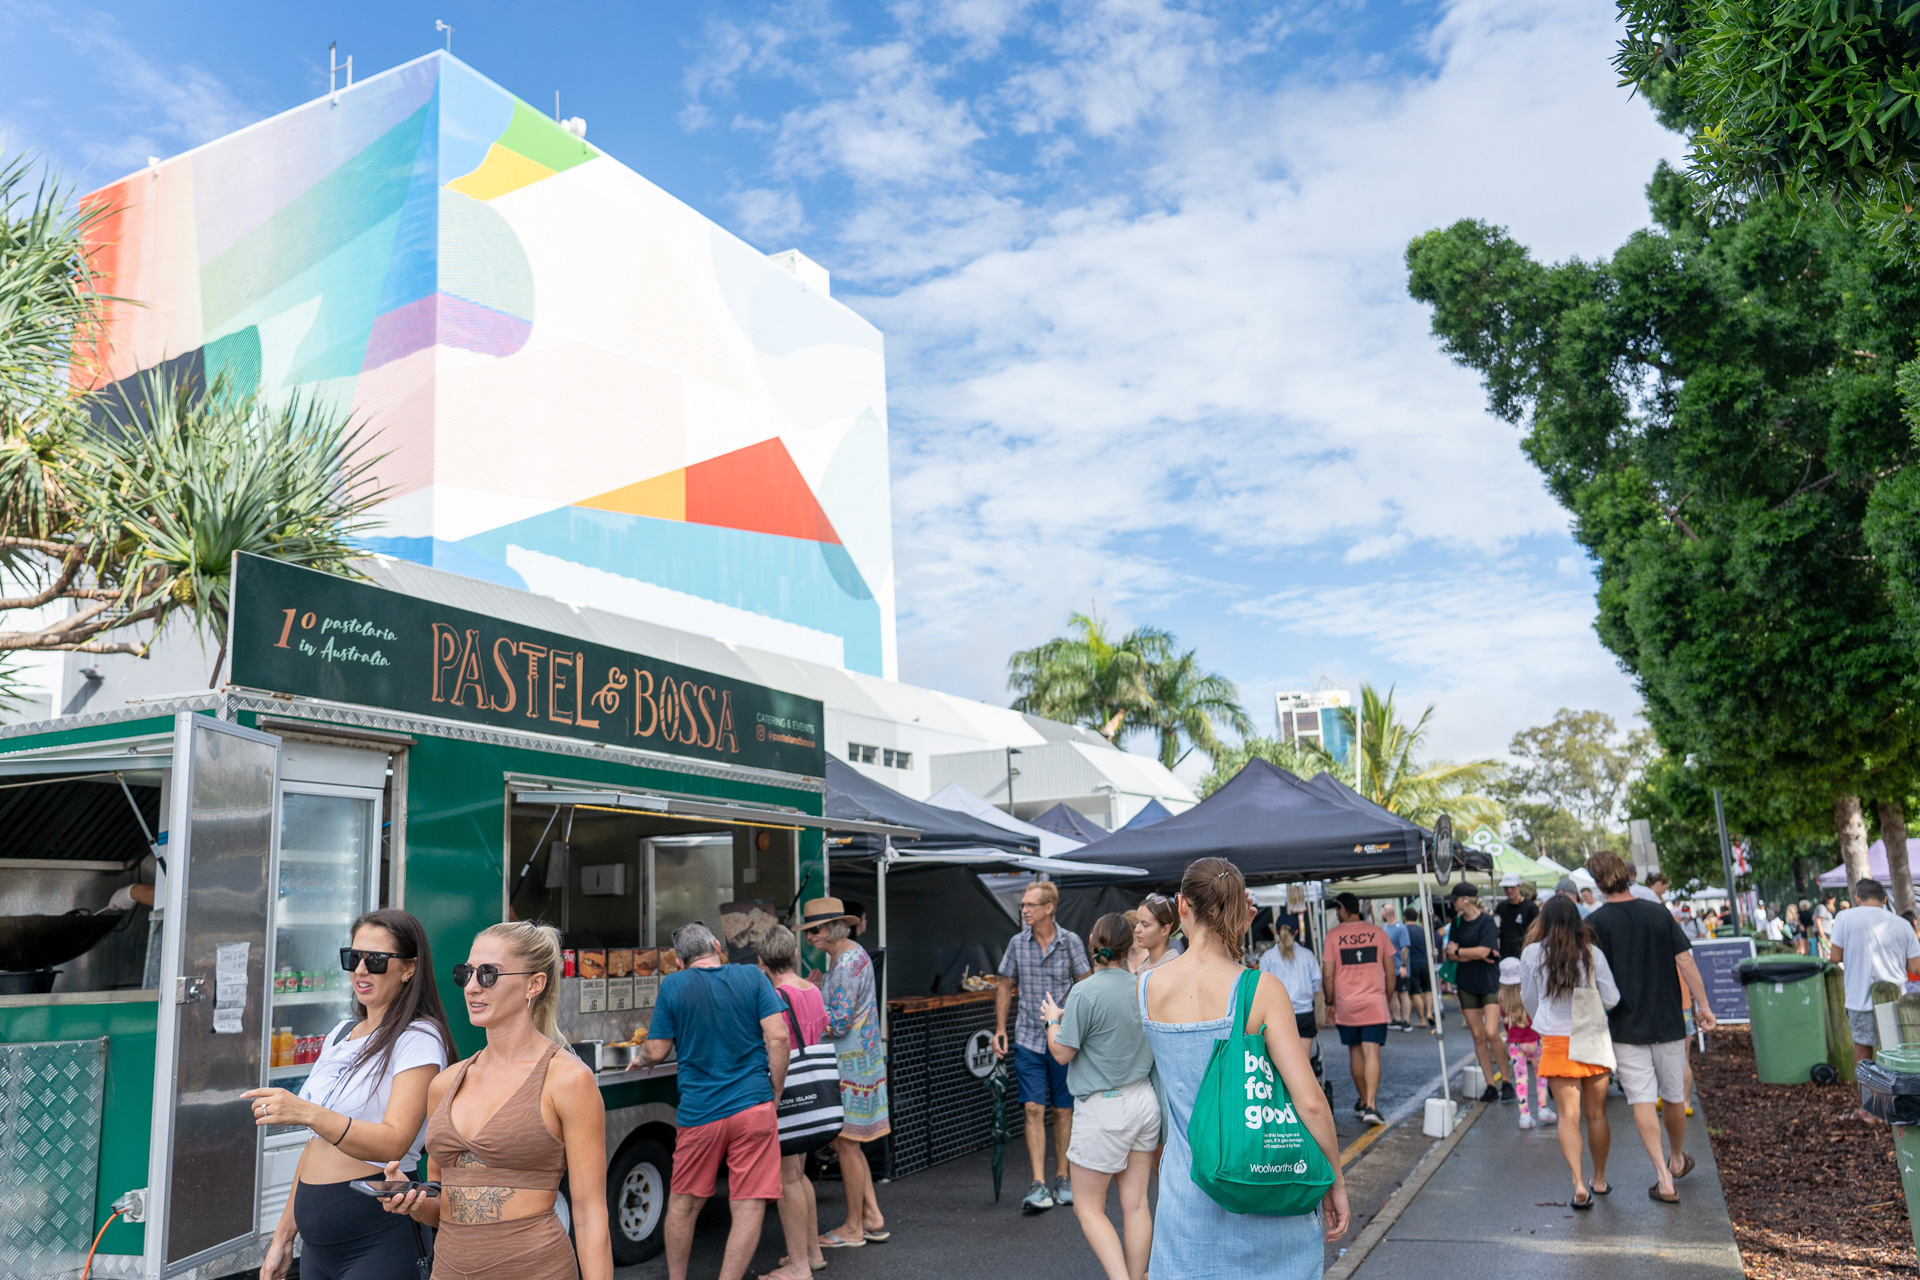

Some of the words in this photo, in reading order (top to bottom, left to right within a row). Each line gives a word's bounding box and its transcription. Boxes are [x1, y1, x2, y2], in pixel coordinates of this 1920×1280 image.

[321, 617, 398, 641] pastelaria
[299, 638, 317, 656] in
[320, 636, 391, 666] Australia
[431, 622, 600, 729] PASTEL
[591, 666, 628, 714] &
[633, 667, 740, 753] BOSSA
[756, 712, 786, 728] CATERING
[792, 720, 815, 734] EVENTS
[1338, 932, 1375, 945] KSCY
[795, 1093, 817, 1103] ISLAND
[1244, 1075, 1273, 1100] for
[1244, 1103, 1298, 1130] good
[1250, 1162, 1293, 1173] Woolworths
